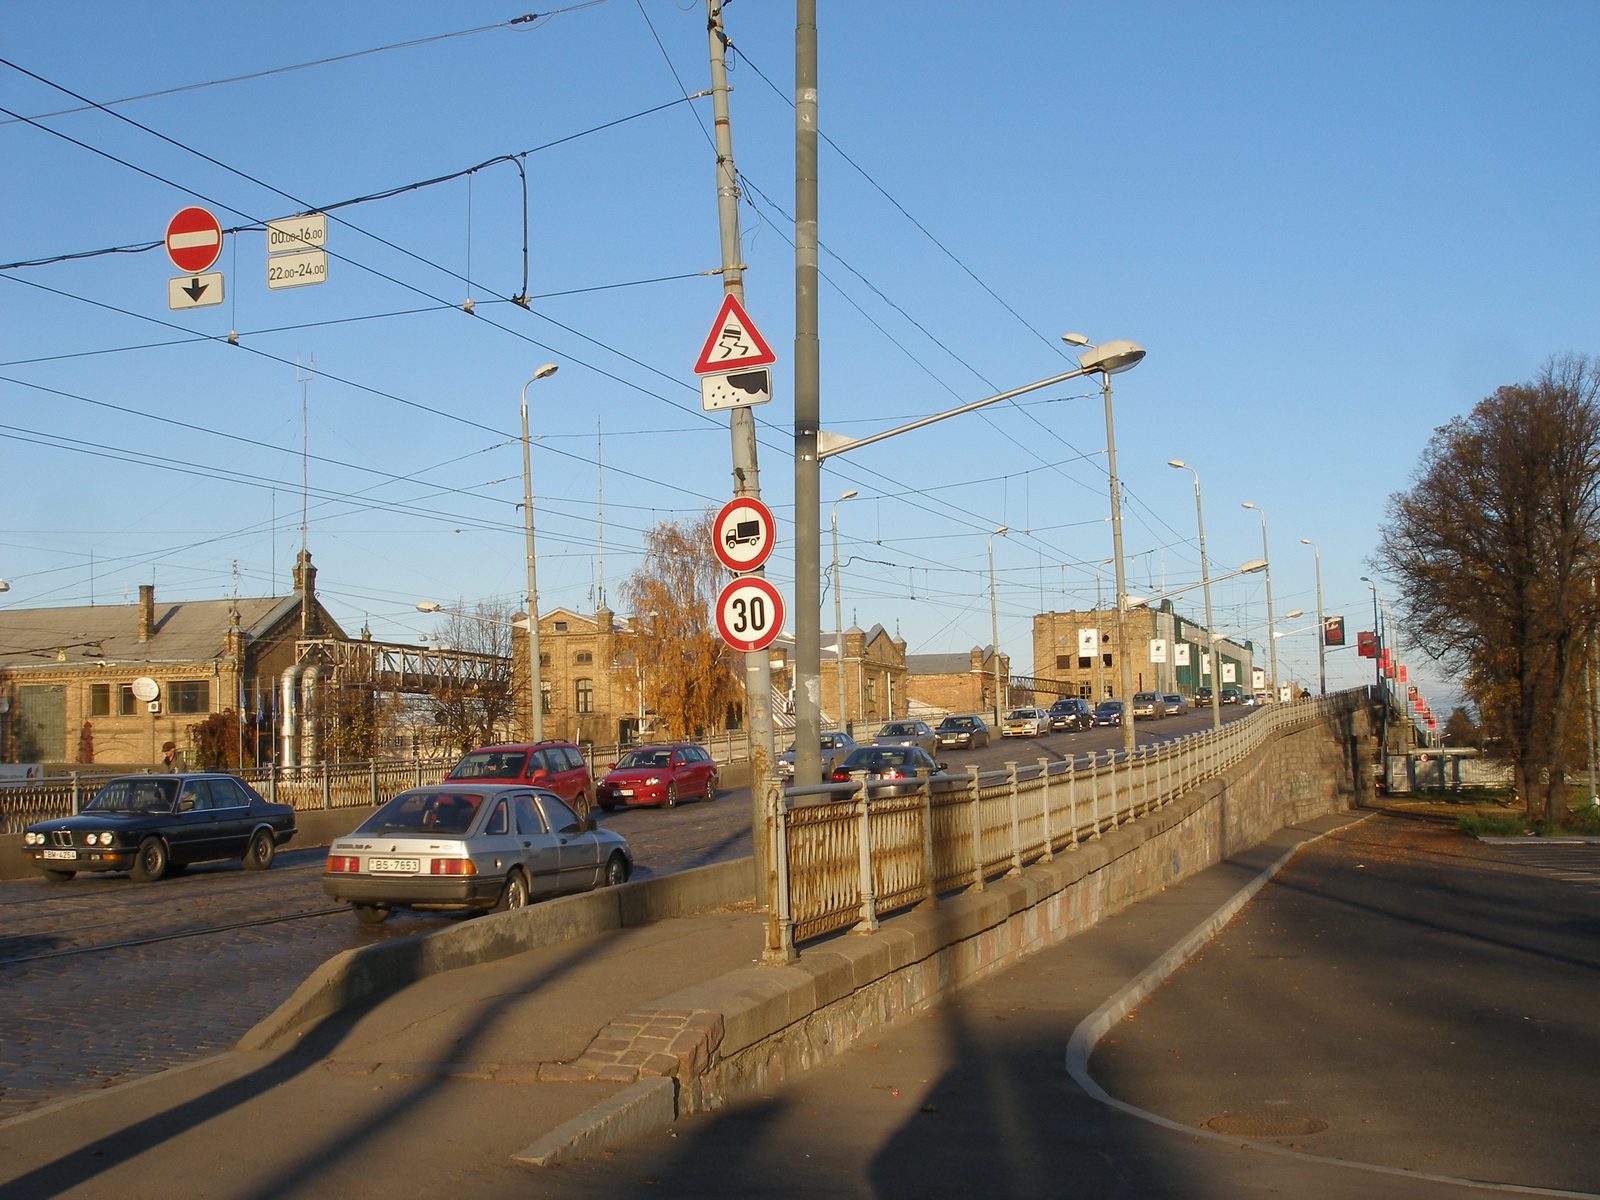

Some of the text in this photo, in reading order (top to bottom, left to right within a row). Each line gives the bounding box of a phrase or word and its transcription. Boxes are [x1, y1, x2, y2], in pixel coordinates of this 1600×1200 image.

[271, 227, 322, 245] 00.00-16.00
[269, 262, 325, 281] 22.00-24.00
[732, 596, 765, 633] 30
